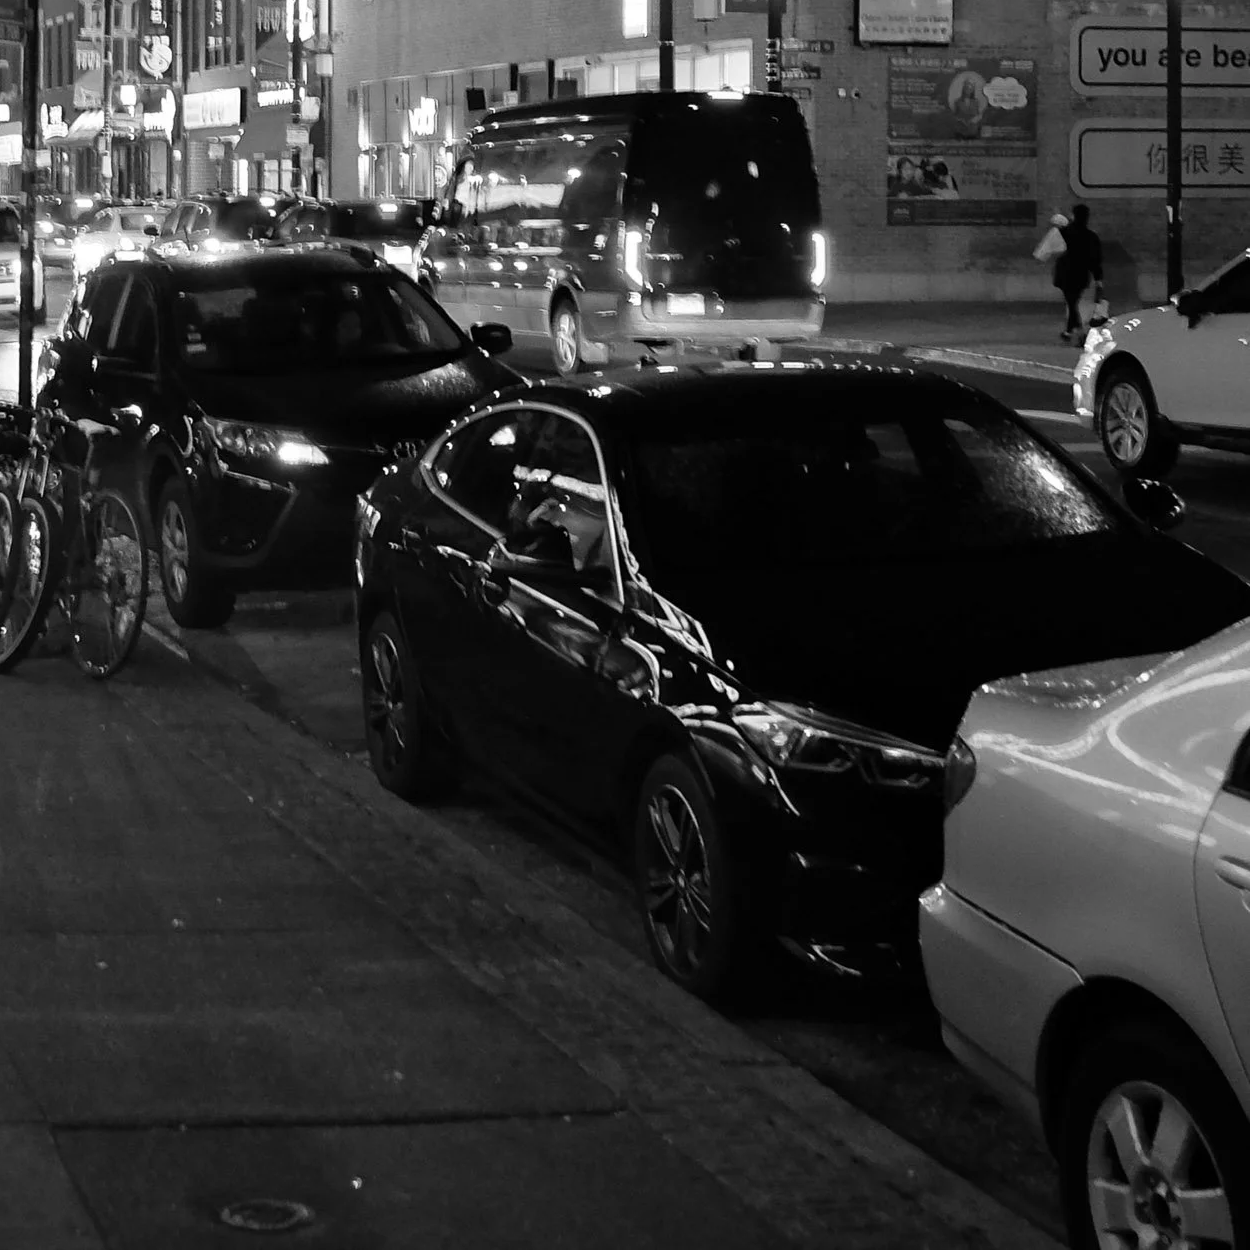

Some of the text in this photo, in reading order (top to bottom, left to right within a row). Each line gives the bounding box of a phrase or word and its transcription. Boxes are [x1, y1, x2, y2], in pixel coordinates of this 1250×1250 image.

[1097, 44, 1250, 73] you ae be
